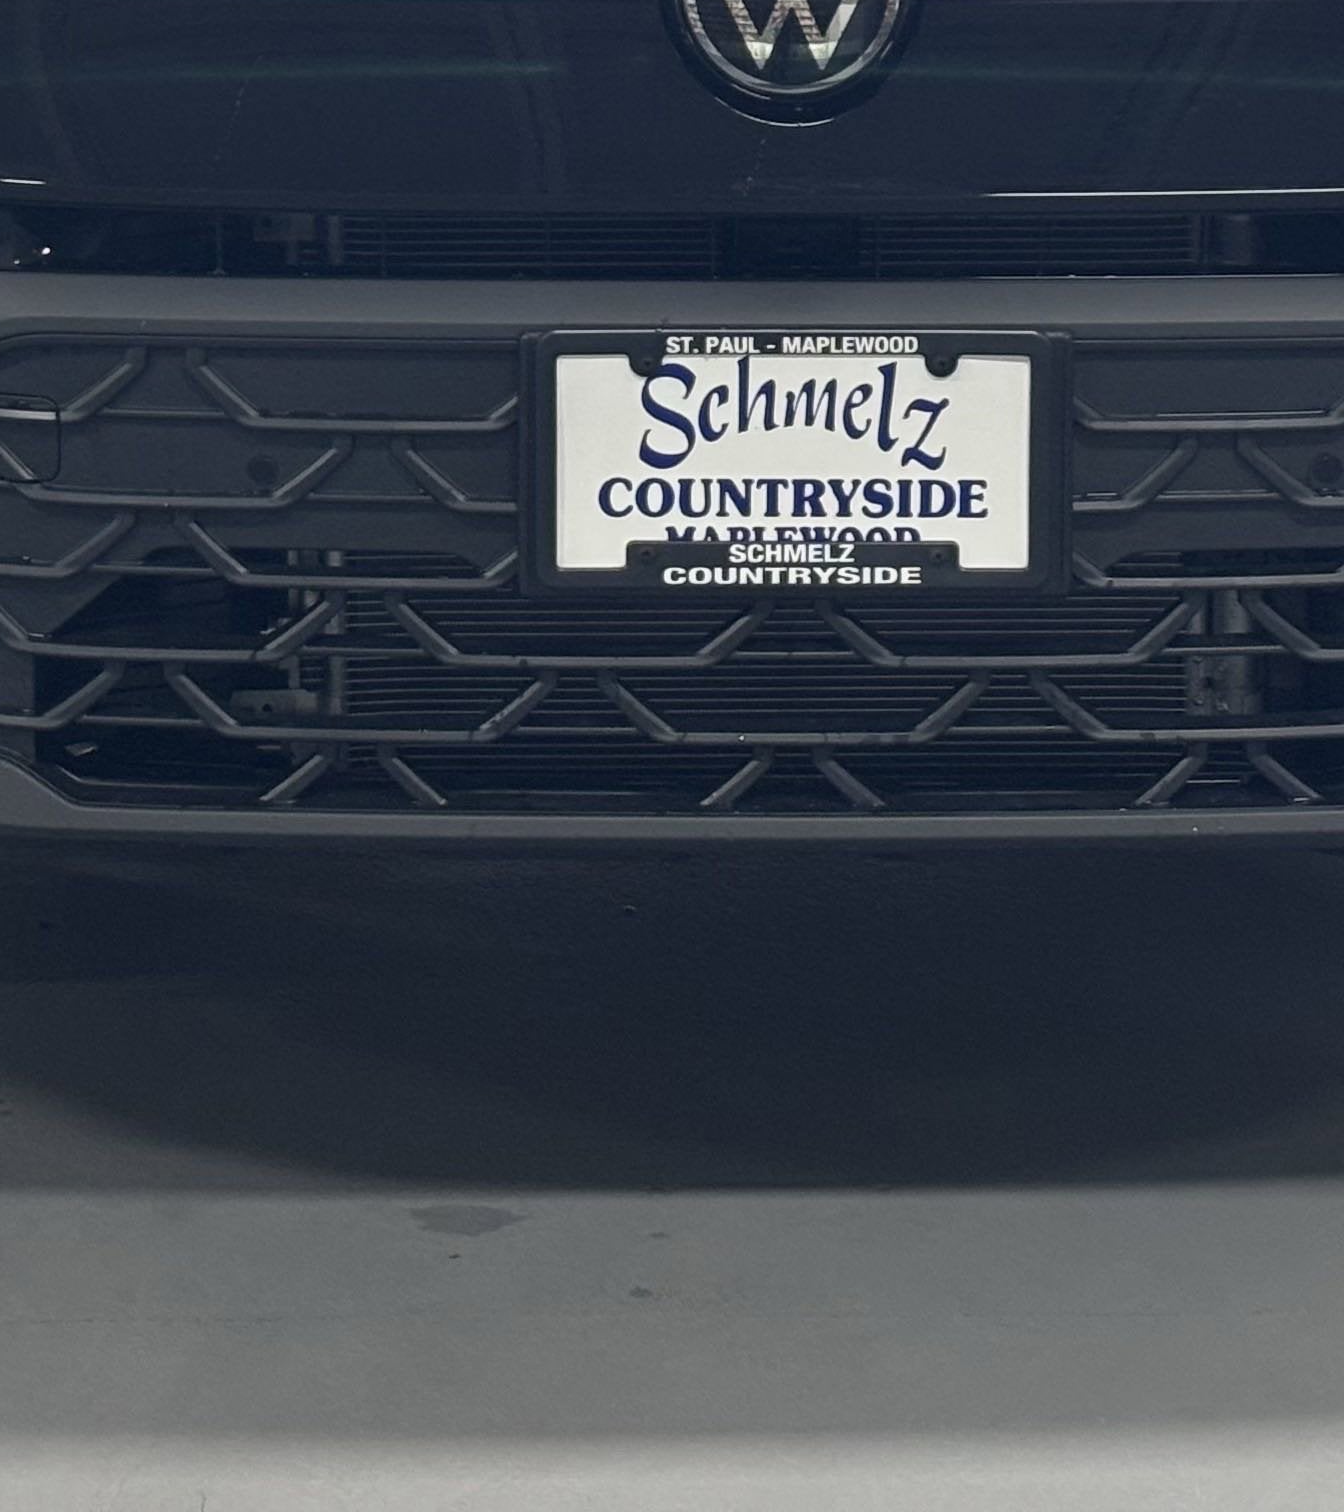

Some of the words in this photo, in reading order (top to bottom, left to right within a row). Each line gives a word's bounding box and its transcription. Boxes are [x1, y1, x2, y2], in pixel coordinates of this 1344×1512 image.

[666, 337, 699, 354] ST.
[707, 337, 761, 354] PAUL
[782, 337, 918, 354] MAPLEWOOD
[639, 356, 949, 470] Schmelz
[598, 477, 989, 518] COUNTRYSIDE
[729, 544, 854, 563] SCHMELZ
[663, 567, 921, 585] COUNTRYSIDE
